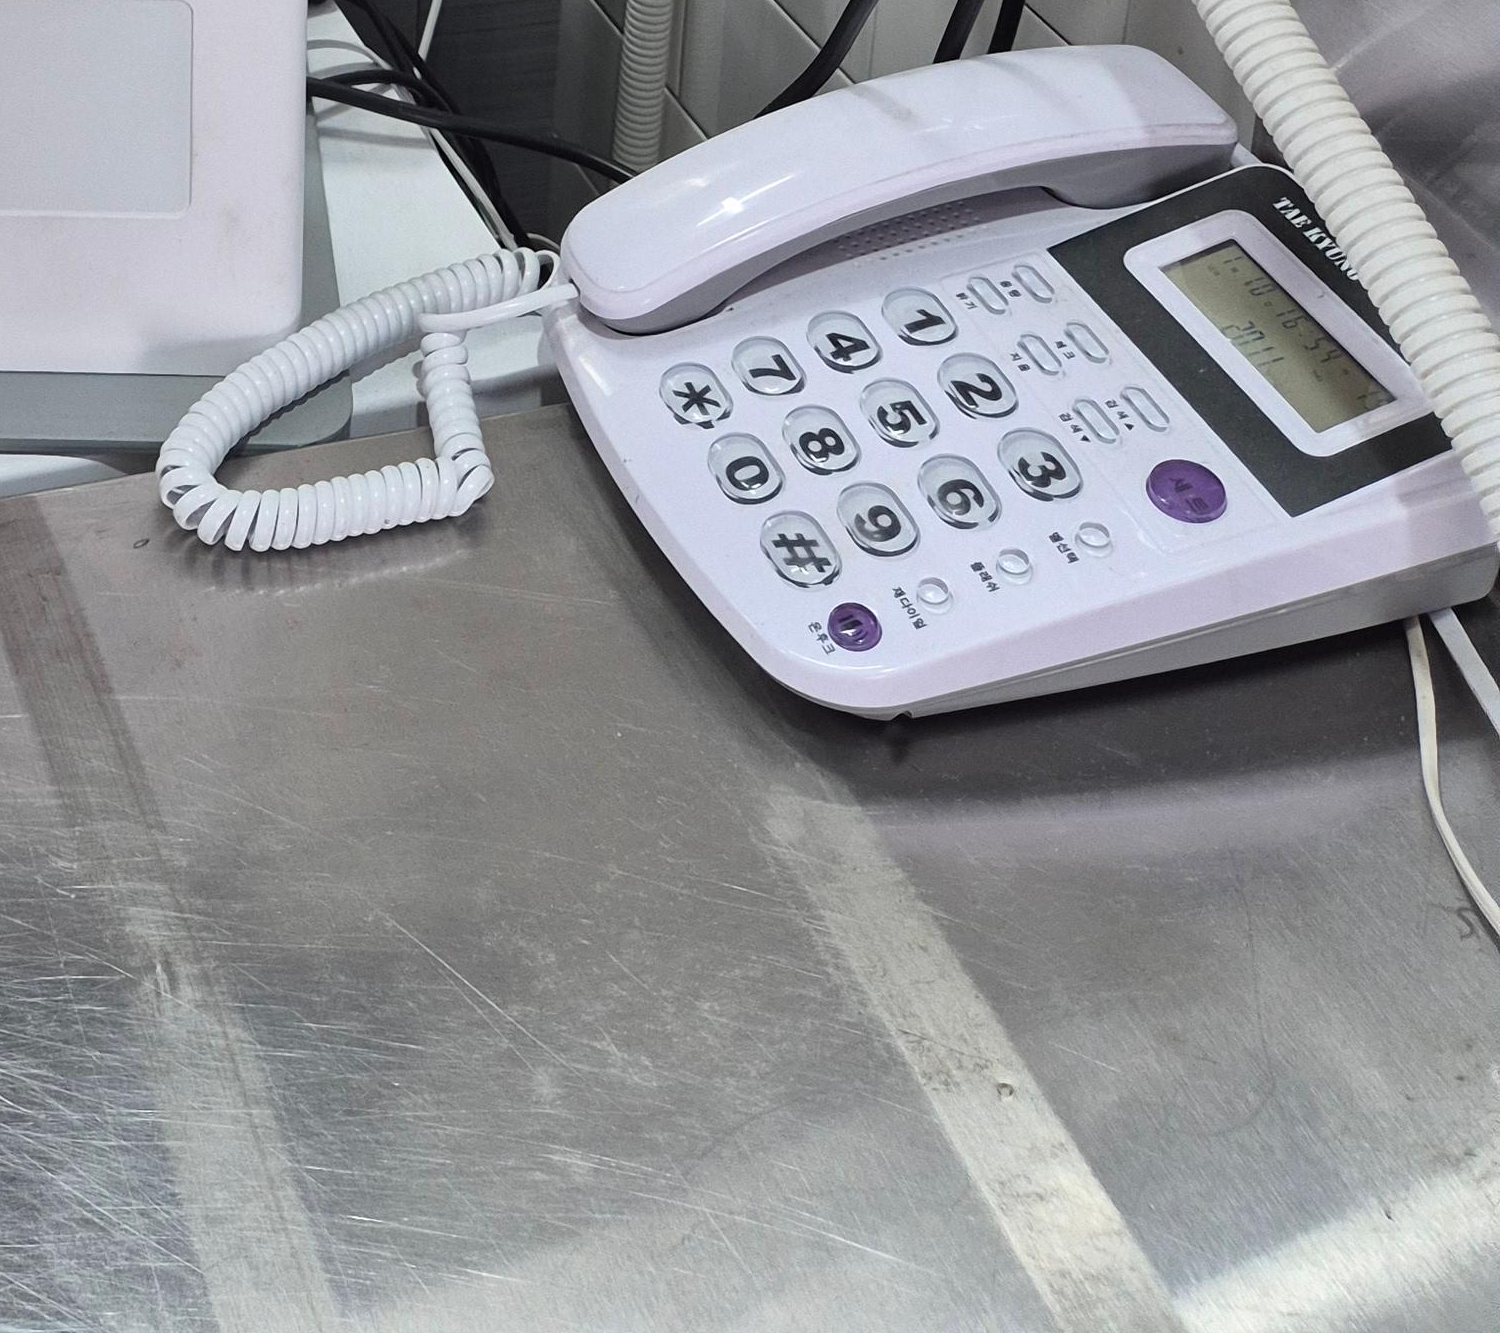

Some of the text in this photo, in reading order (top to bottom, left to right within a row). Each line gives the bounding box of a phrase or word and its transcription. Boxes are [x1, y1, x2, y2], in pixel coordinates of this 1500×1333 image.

[1272, 196, 1312, 228] TAE
[904, 308, 946, 334] 1
[826, 331, 871, 362] 4
[749, 354, 796, 382] 7
[950, 372, 1003, 409] 2
[877, 400, 927, 434] 5
[799, 428, 845, 462] 8
[725, 456, 769, 491] 0
[1018, 451, 1067, 488] 3
[937, 479, 984, 516] 6
[854, 505, 901, 542] 9
